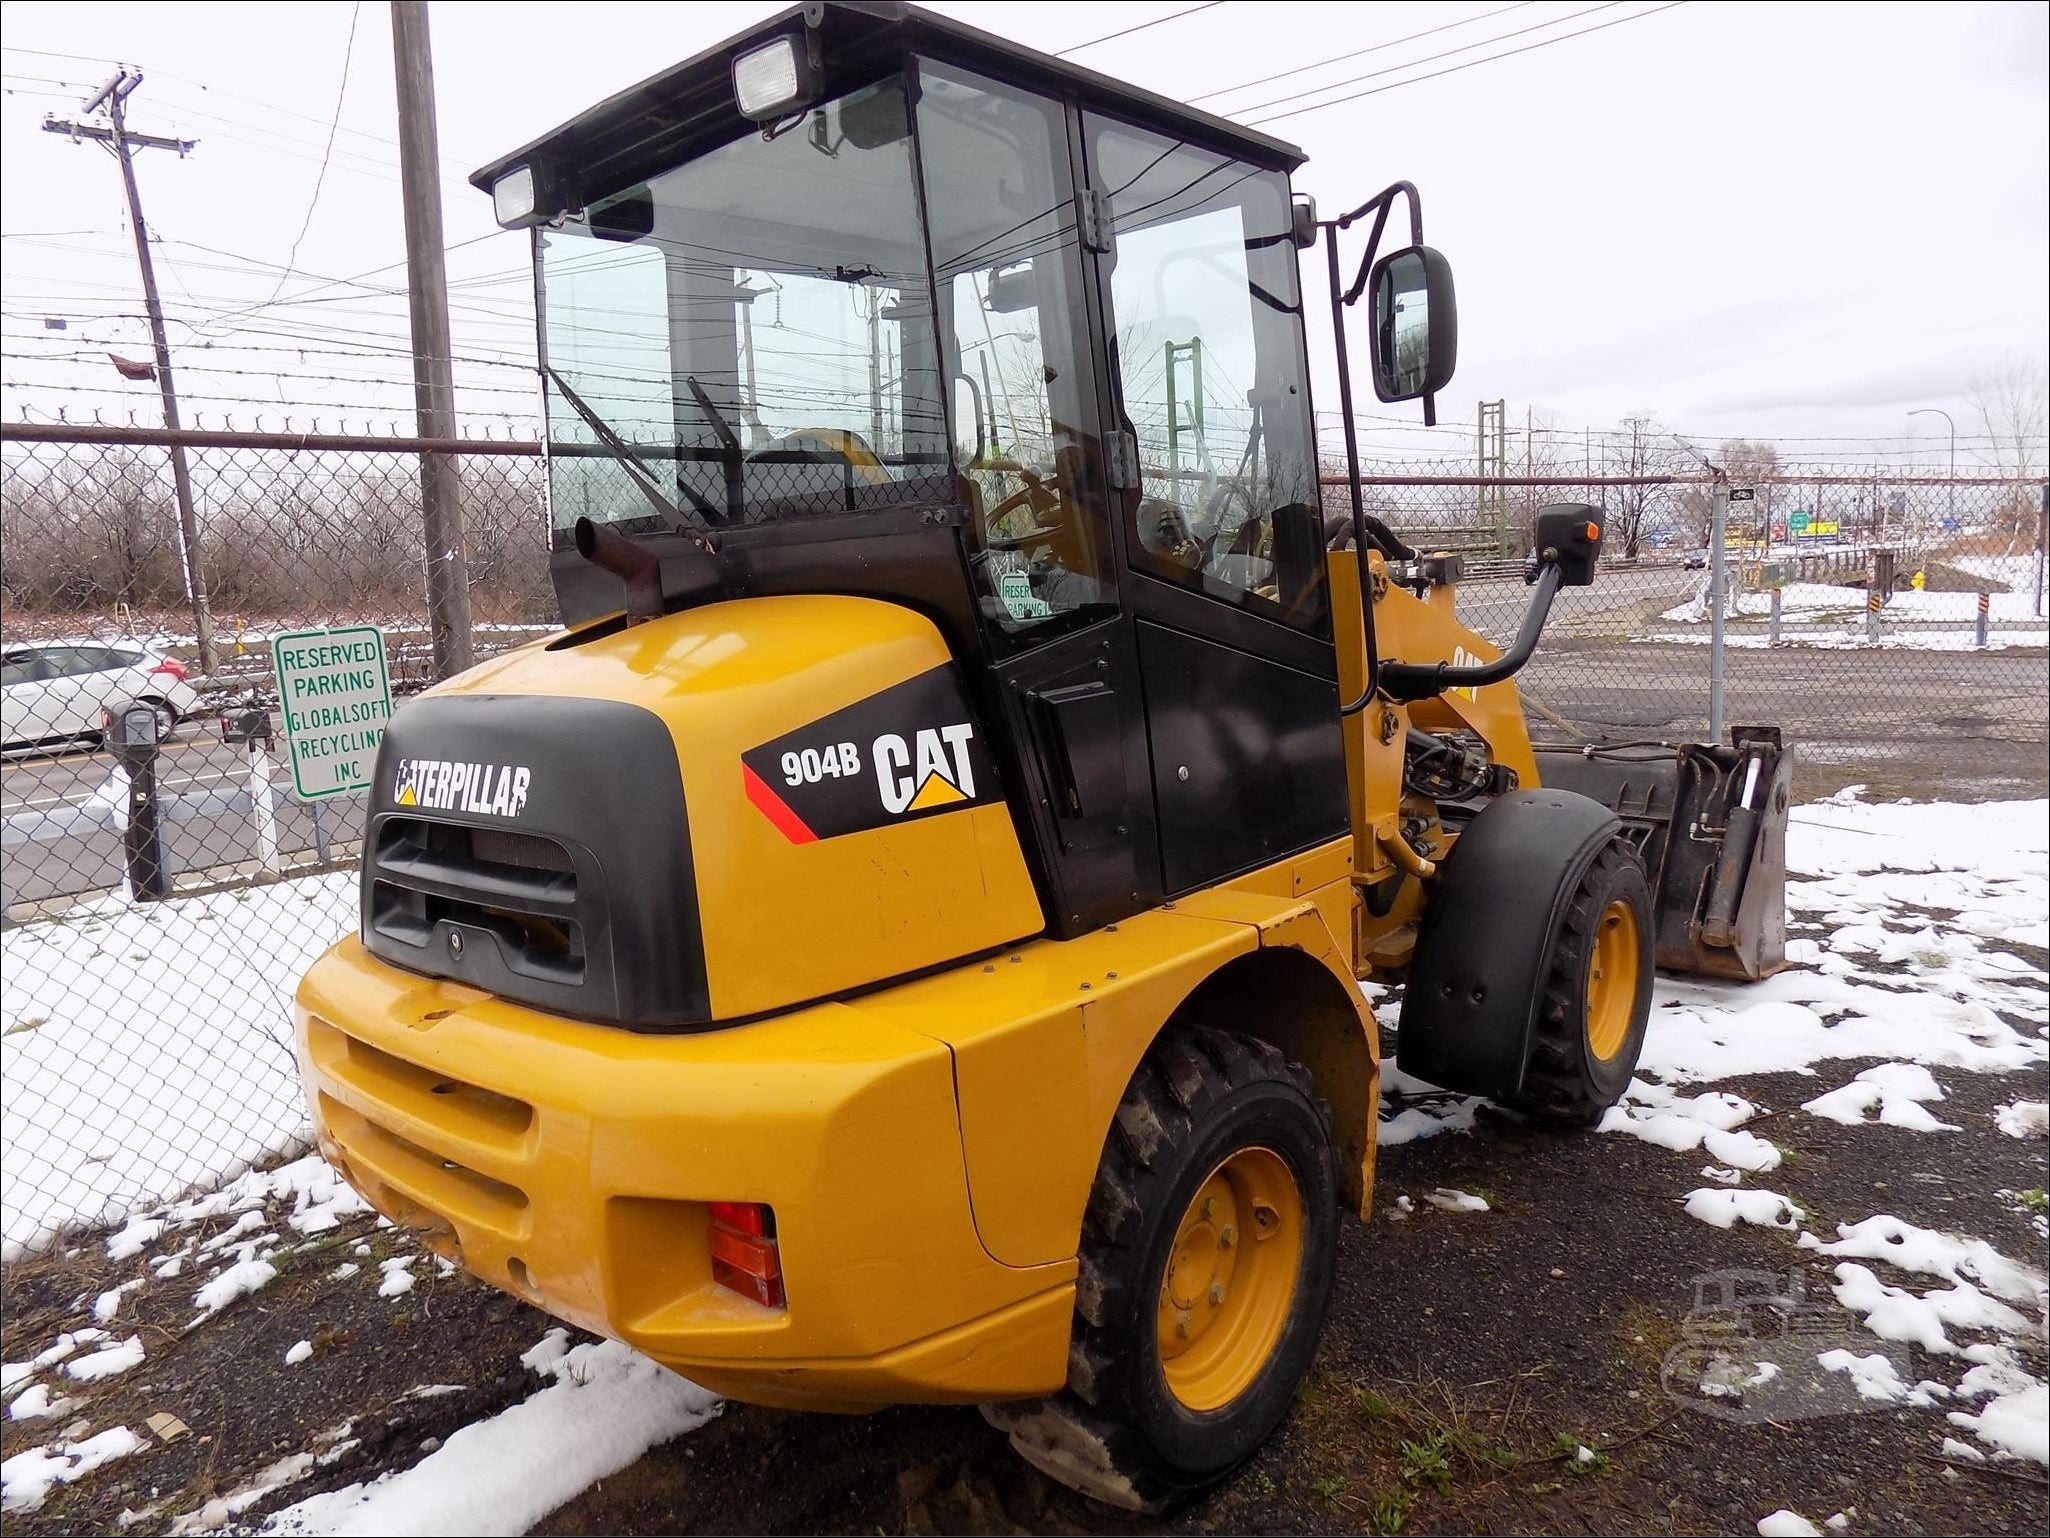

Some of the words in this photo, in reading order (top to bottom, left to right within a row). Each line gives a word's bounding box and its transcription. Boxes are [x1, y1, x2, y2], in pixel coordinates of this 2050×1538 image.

[1005, 585, 1030, 598] RESER
[283, 642, 377, 671] RESERVED
[294, 669, 375, 698] PARKING
[290, 700, 387, 732] GLOBALSOFT
[334, 761, 362, 782] INC
[780, 742, 861, 787] 904B
[872, 722, 976, 814] CAT
[394, 758, 531, 818] CATERPILLAR
